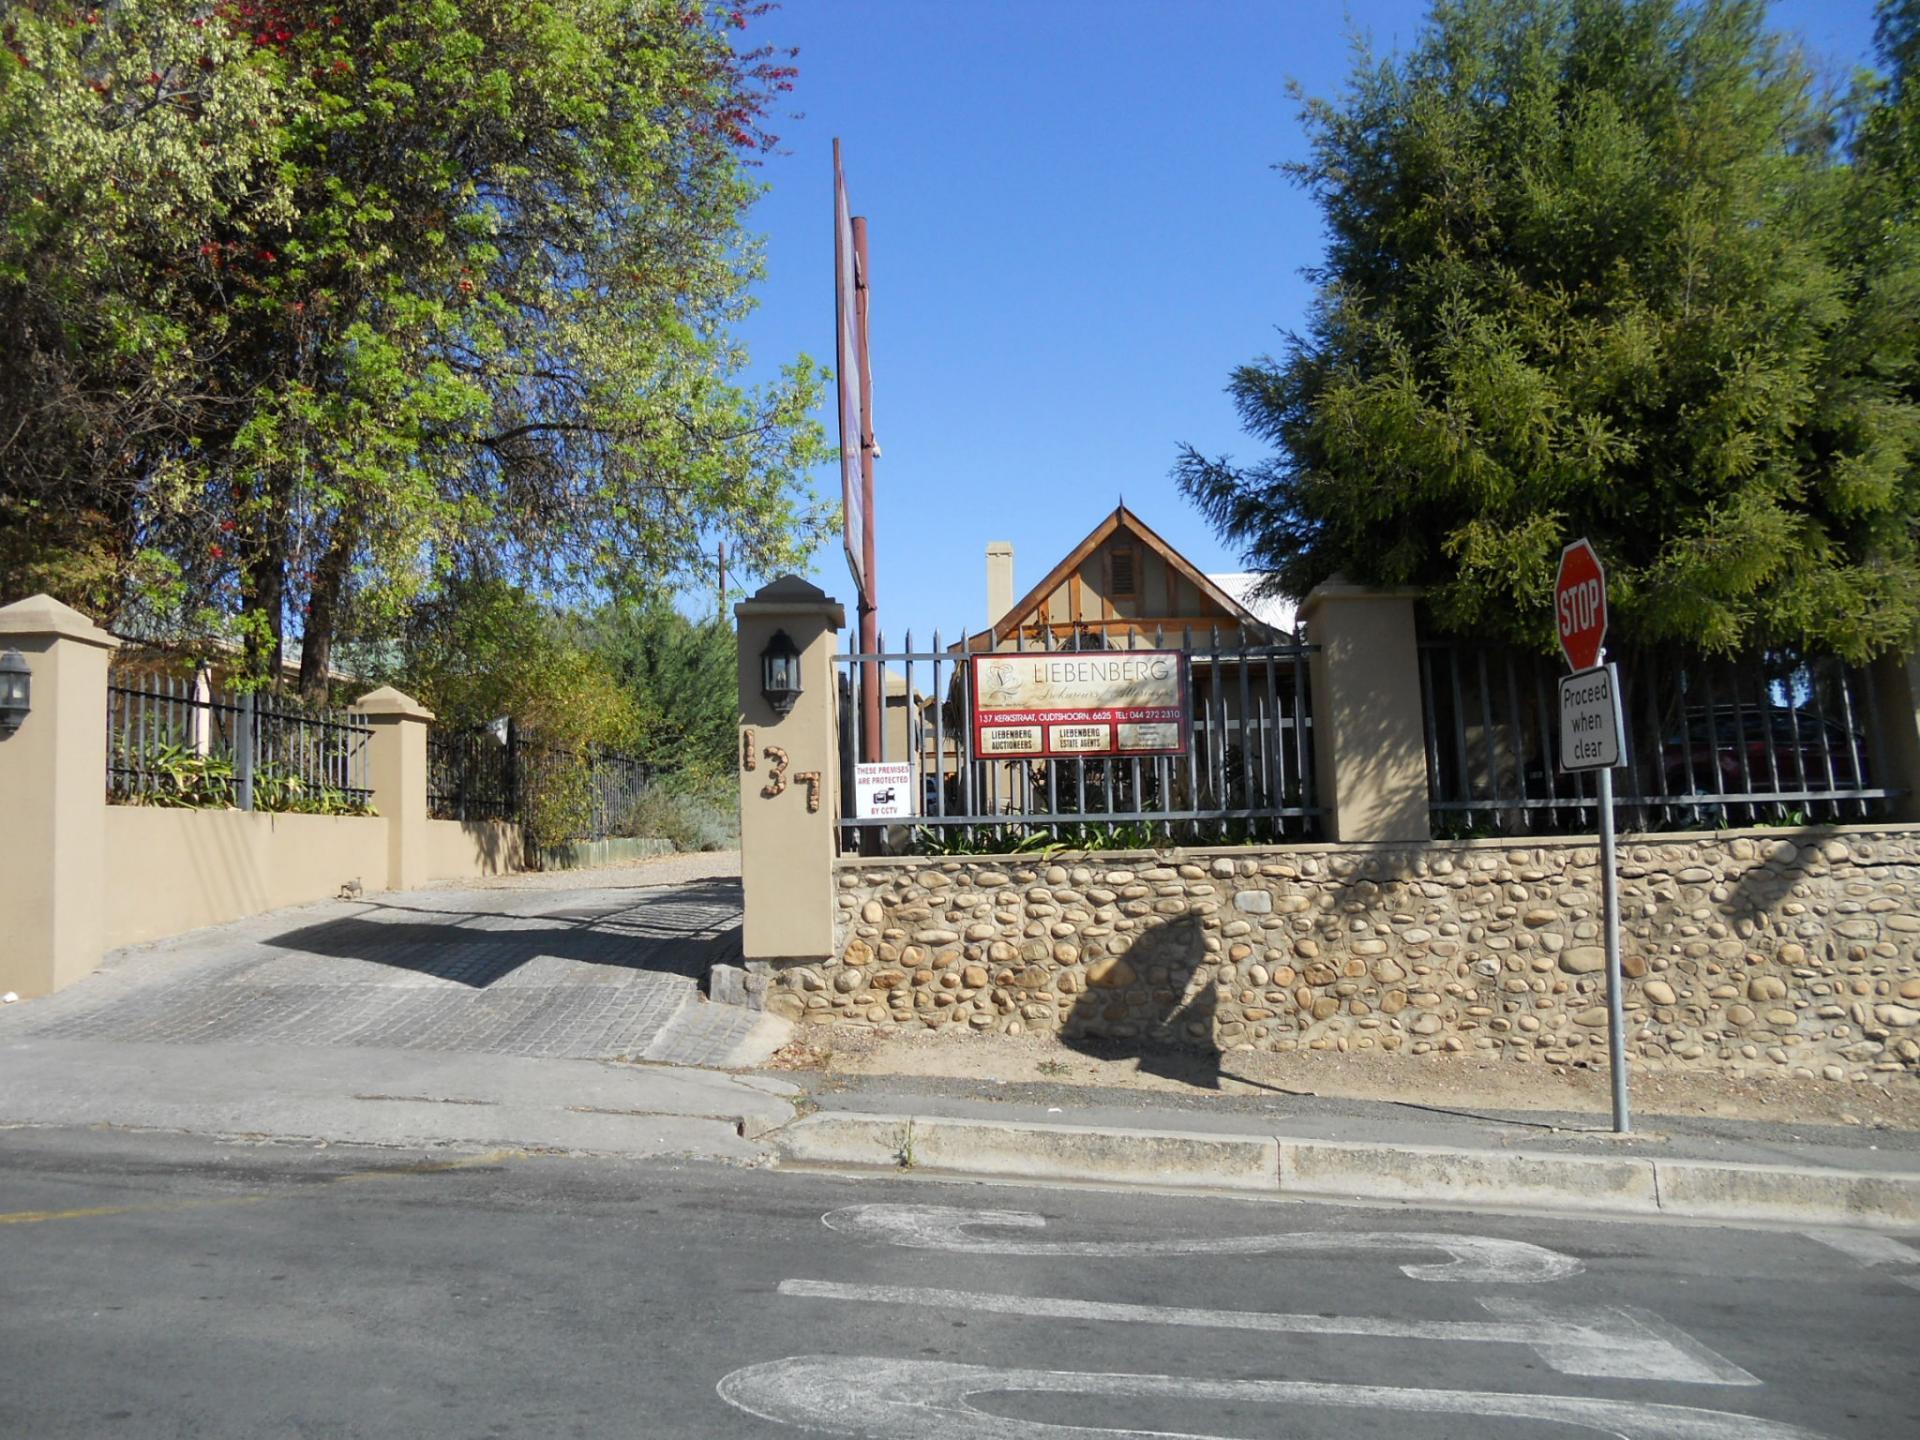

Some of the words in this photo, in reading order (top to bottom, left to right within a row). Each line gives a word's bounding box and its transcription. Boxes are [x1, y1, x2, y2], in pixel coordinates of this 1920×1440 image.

[1559, 577, 1600, 637] STOP
[1034, 660, 1169, 683] LIEBENBERG
[1563, 679, 1608, 710] Proceed
[979, 714, 992, 723] 137
[1092, 712, 1112, 720] 6625
[1115, 711, 1128, 720] TEL:
[1129, 711, 1145, 719] 044
[1146, 710, 1159, 719] 272
[1161, 710, 1180, 719] 2310
[1571, 712, 1602, 733] when
[991, 729, 1032, 740] LIEBENBERG
[1059, 728, 1101, 738] LIEBENBERG
[991, 740, 1033, 750] AUCTIONEERS
[1059, 739, 1079, 748] ESTATE
[1080, 738, 1101, 748] AGENTS
[1573, 740, 1603, 761] clear
[743, 728, 821, 814] 137
[856, 766, 876, 775] THESE
[878, 766, 909, 775] PREMISES
[857, 776, 871, 785] ARE
[872, 776, 909, 785] PROTECTED
[870, 807, 880, 816] BY
[881, 807, 898, 815] CCTV
